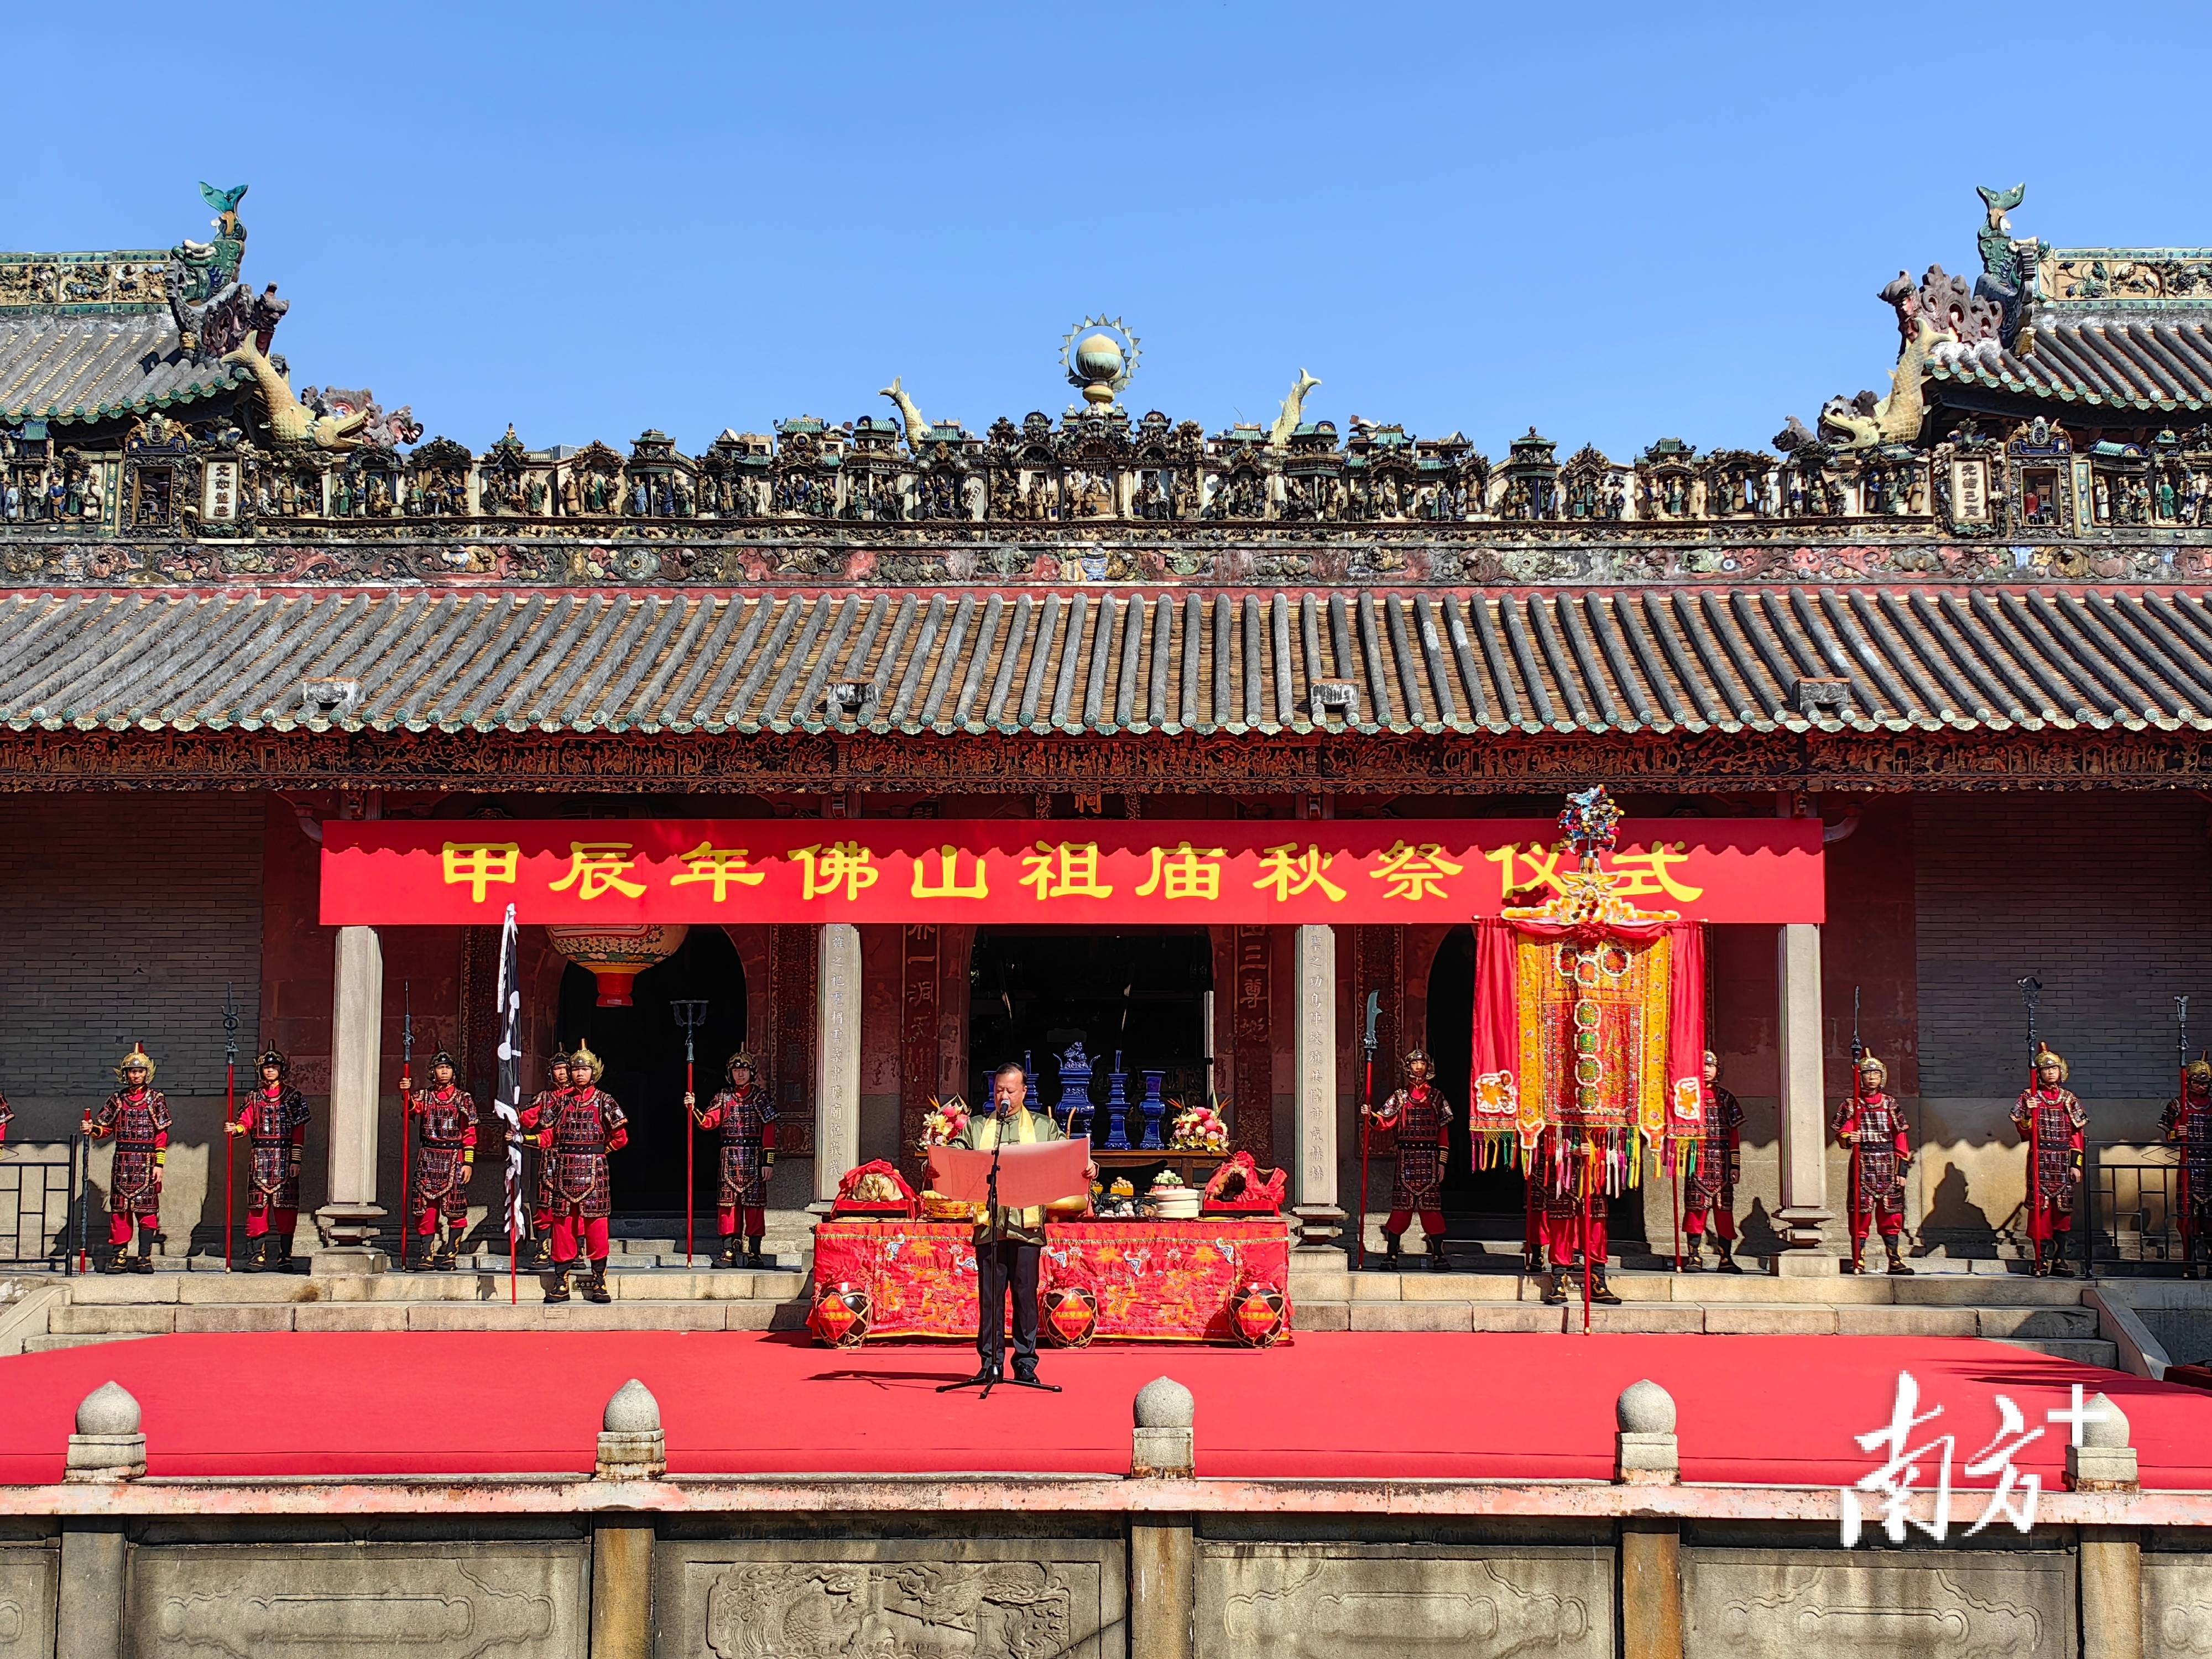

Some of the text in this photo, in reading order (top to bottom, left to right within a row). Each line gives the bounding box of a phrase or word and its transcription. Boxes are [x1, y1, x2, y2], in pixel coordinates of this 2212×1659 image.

[441, 840, 1704, 905] 甲辰年佛山祖庙秋祭仪式
